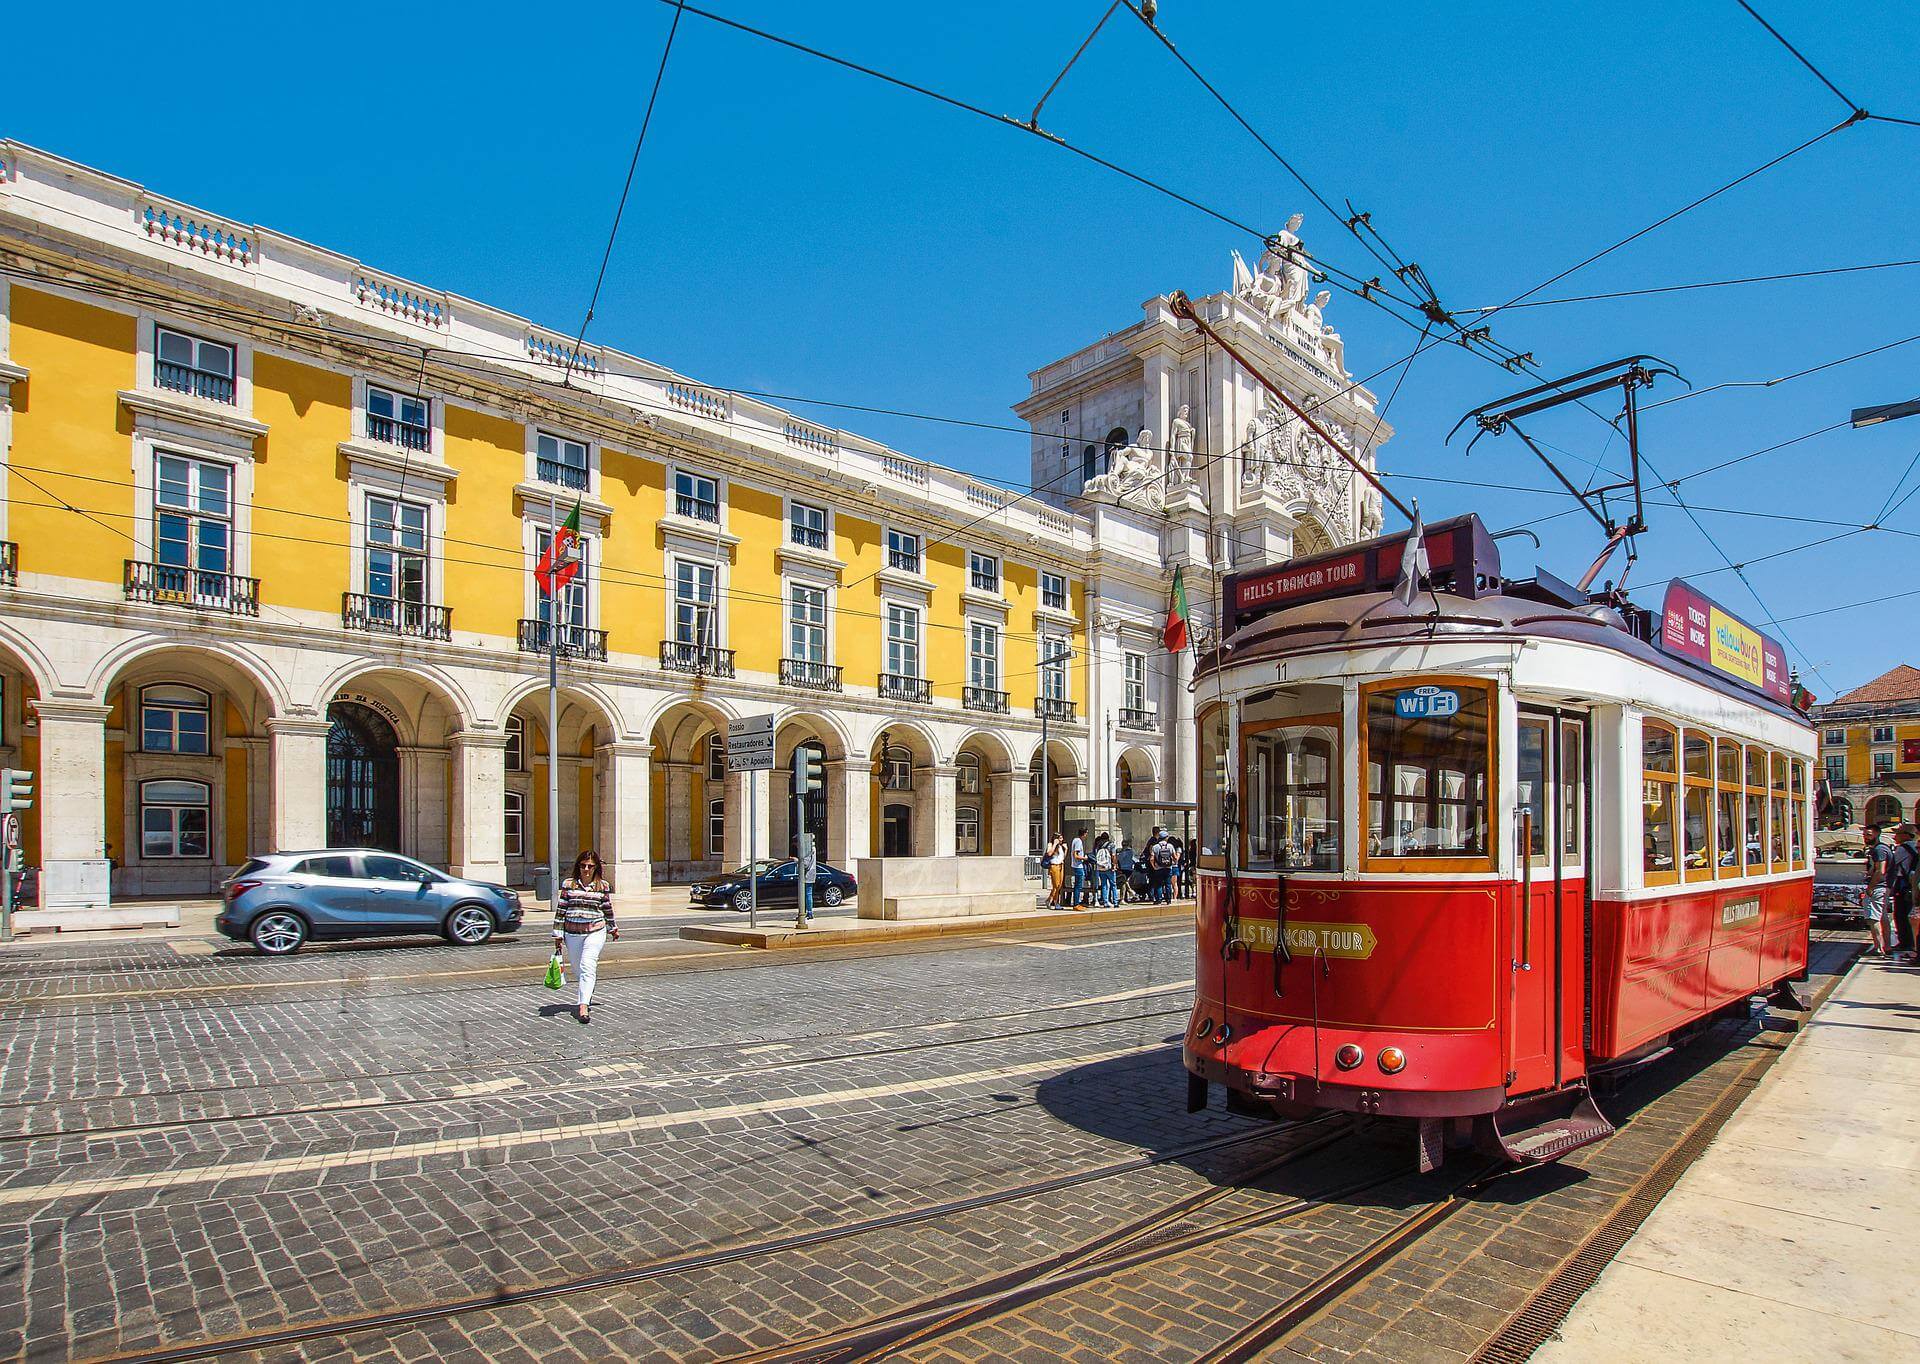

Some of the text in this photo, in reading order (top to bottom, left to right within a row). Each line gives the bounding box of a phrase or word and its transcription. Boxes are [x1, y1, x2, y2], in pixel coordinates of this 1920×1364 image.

[1243, 582, 1274, 601] HILLS
[1326, 562, 1357, 585] TOUR
[1688, 606, 1705, 628] TICKETS
[1275, 662, 1287, 681] 11
[1418, 687, 1436, 695] FREE
[729, 723, 744, 732] Rossio
[728, 740, 764, 750] Restauradores
[1231, 923, 1256, 943] ILLS
[1321, 930, 1363, 951] TOUR
